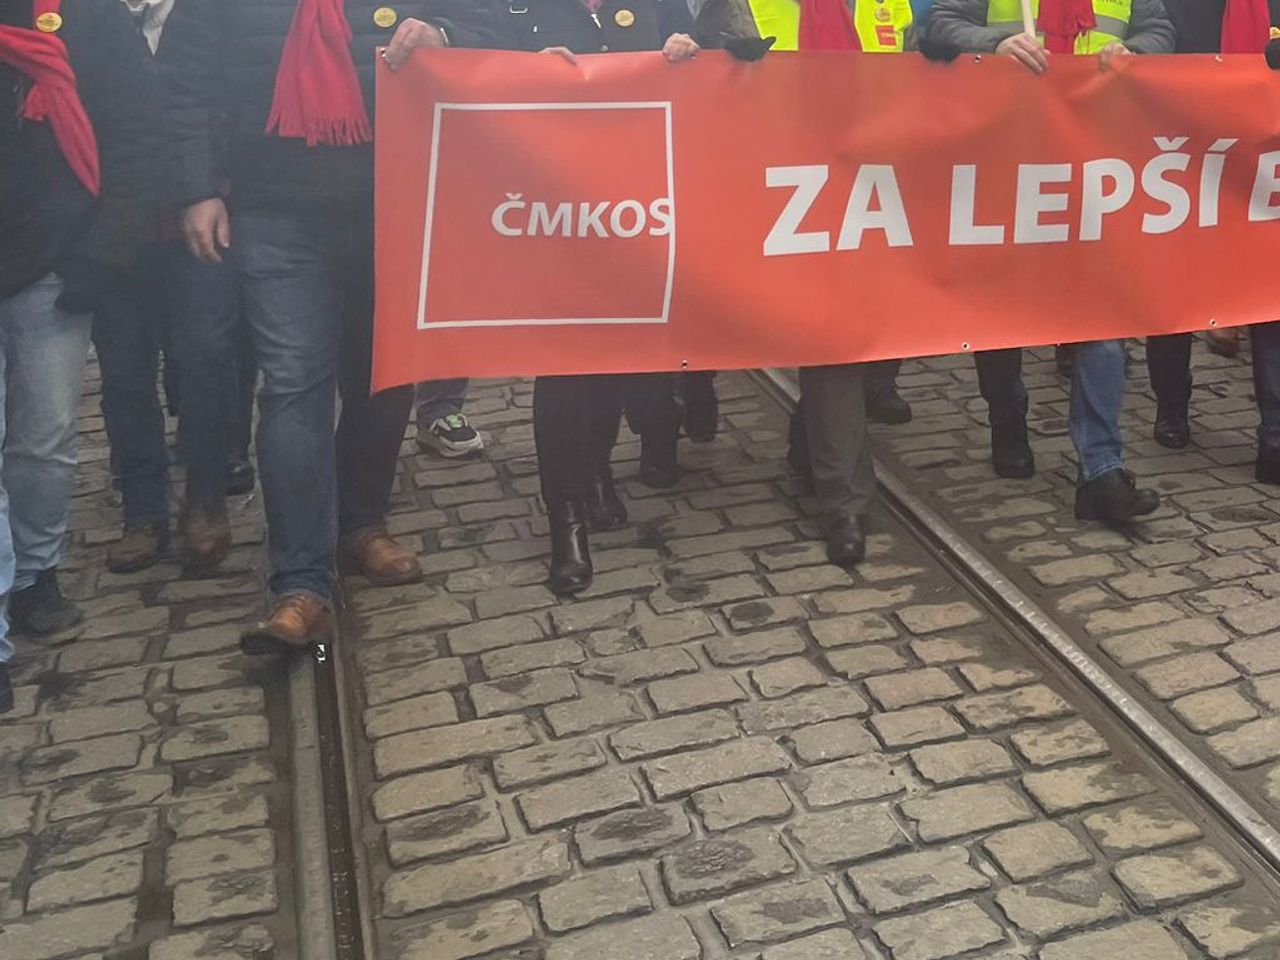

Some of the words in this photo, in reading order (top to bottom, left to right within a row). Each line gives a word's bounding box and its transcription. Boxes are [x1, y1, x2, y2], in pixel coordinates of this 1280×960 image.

[491, 192, 674, 238] ČMKOS
[763, 163, 913, 257] ZA
[948, 136, 1239, 245] LEPŠÍ
